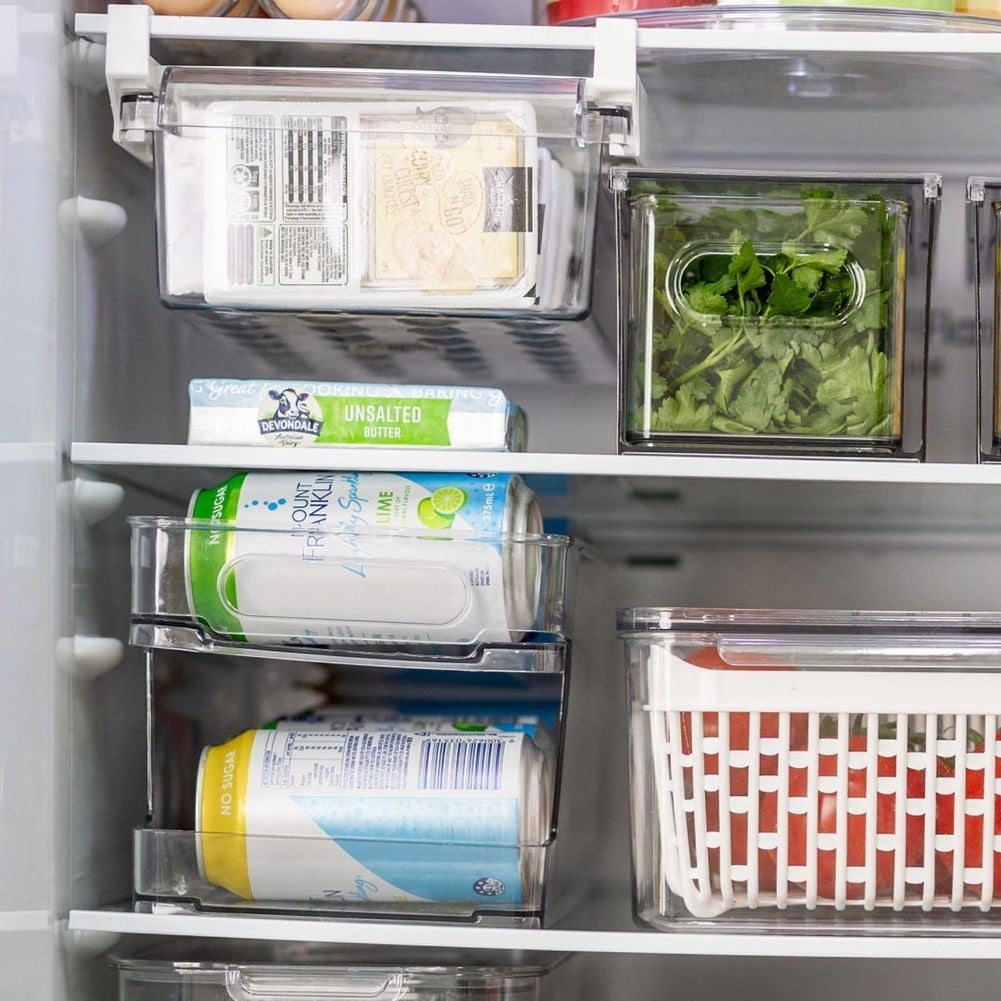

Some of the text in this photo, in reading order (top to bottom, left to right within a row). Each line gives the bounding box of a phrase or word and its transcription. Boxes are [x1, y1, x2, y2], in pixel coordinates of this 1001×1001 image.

[207, 381, 254, 399] Great
[297, 384, 378, 398] OOKING
[344, 405, 422, 424] UNSALTED
[261, 420, 320, 433] DEVONDALE
[363, 426, 401, 438] BUTTER
[213, 484, 229, 519] SUGAR
[375, 491, 394, 524] LIME
[481, 493, 495, 521] 375mL
[220, 749, 237, 817] NO SUGAR
